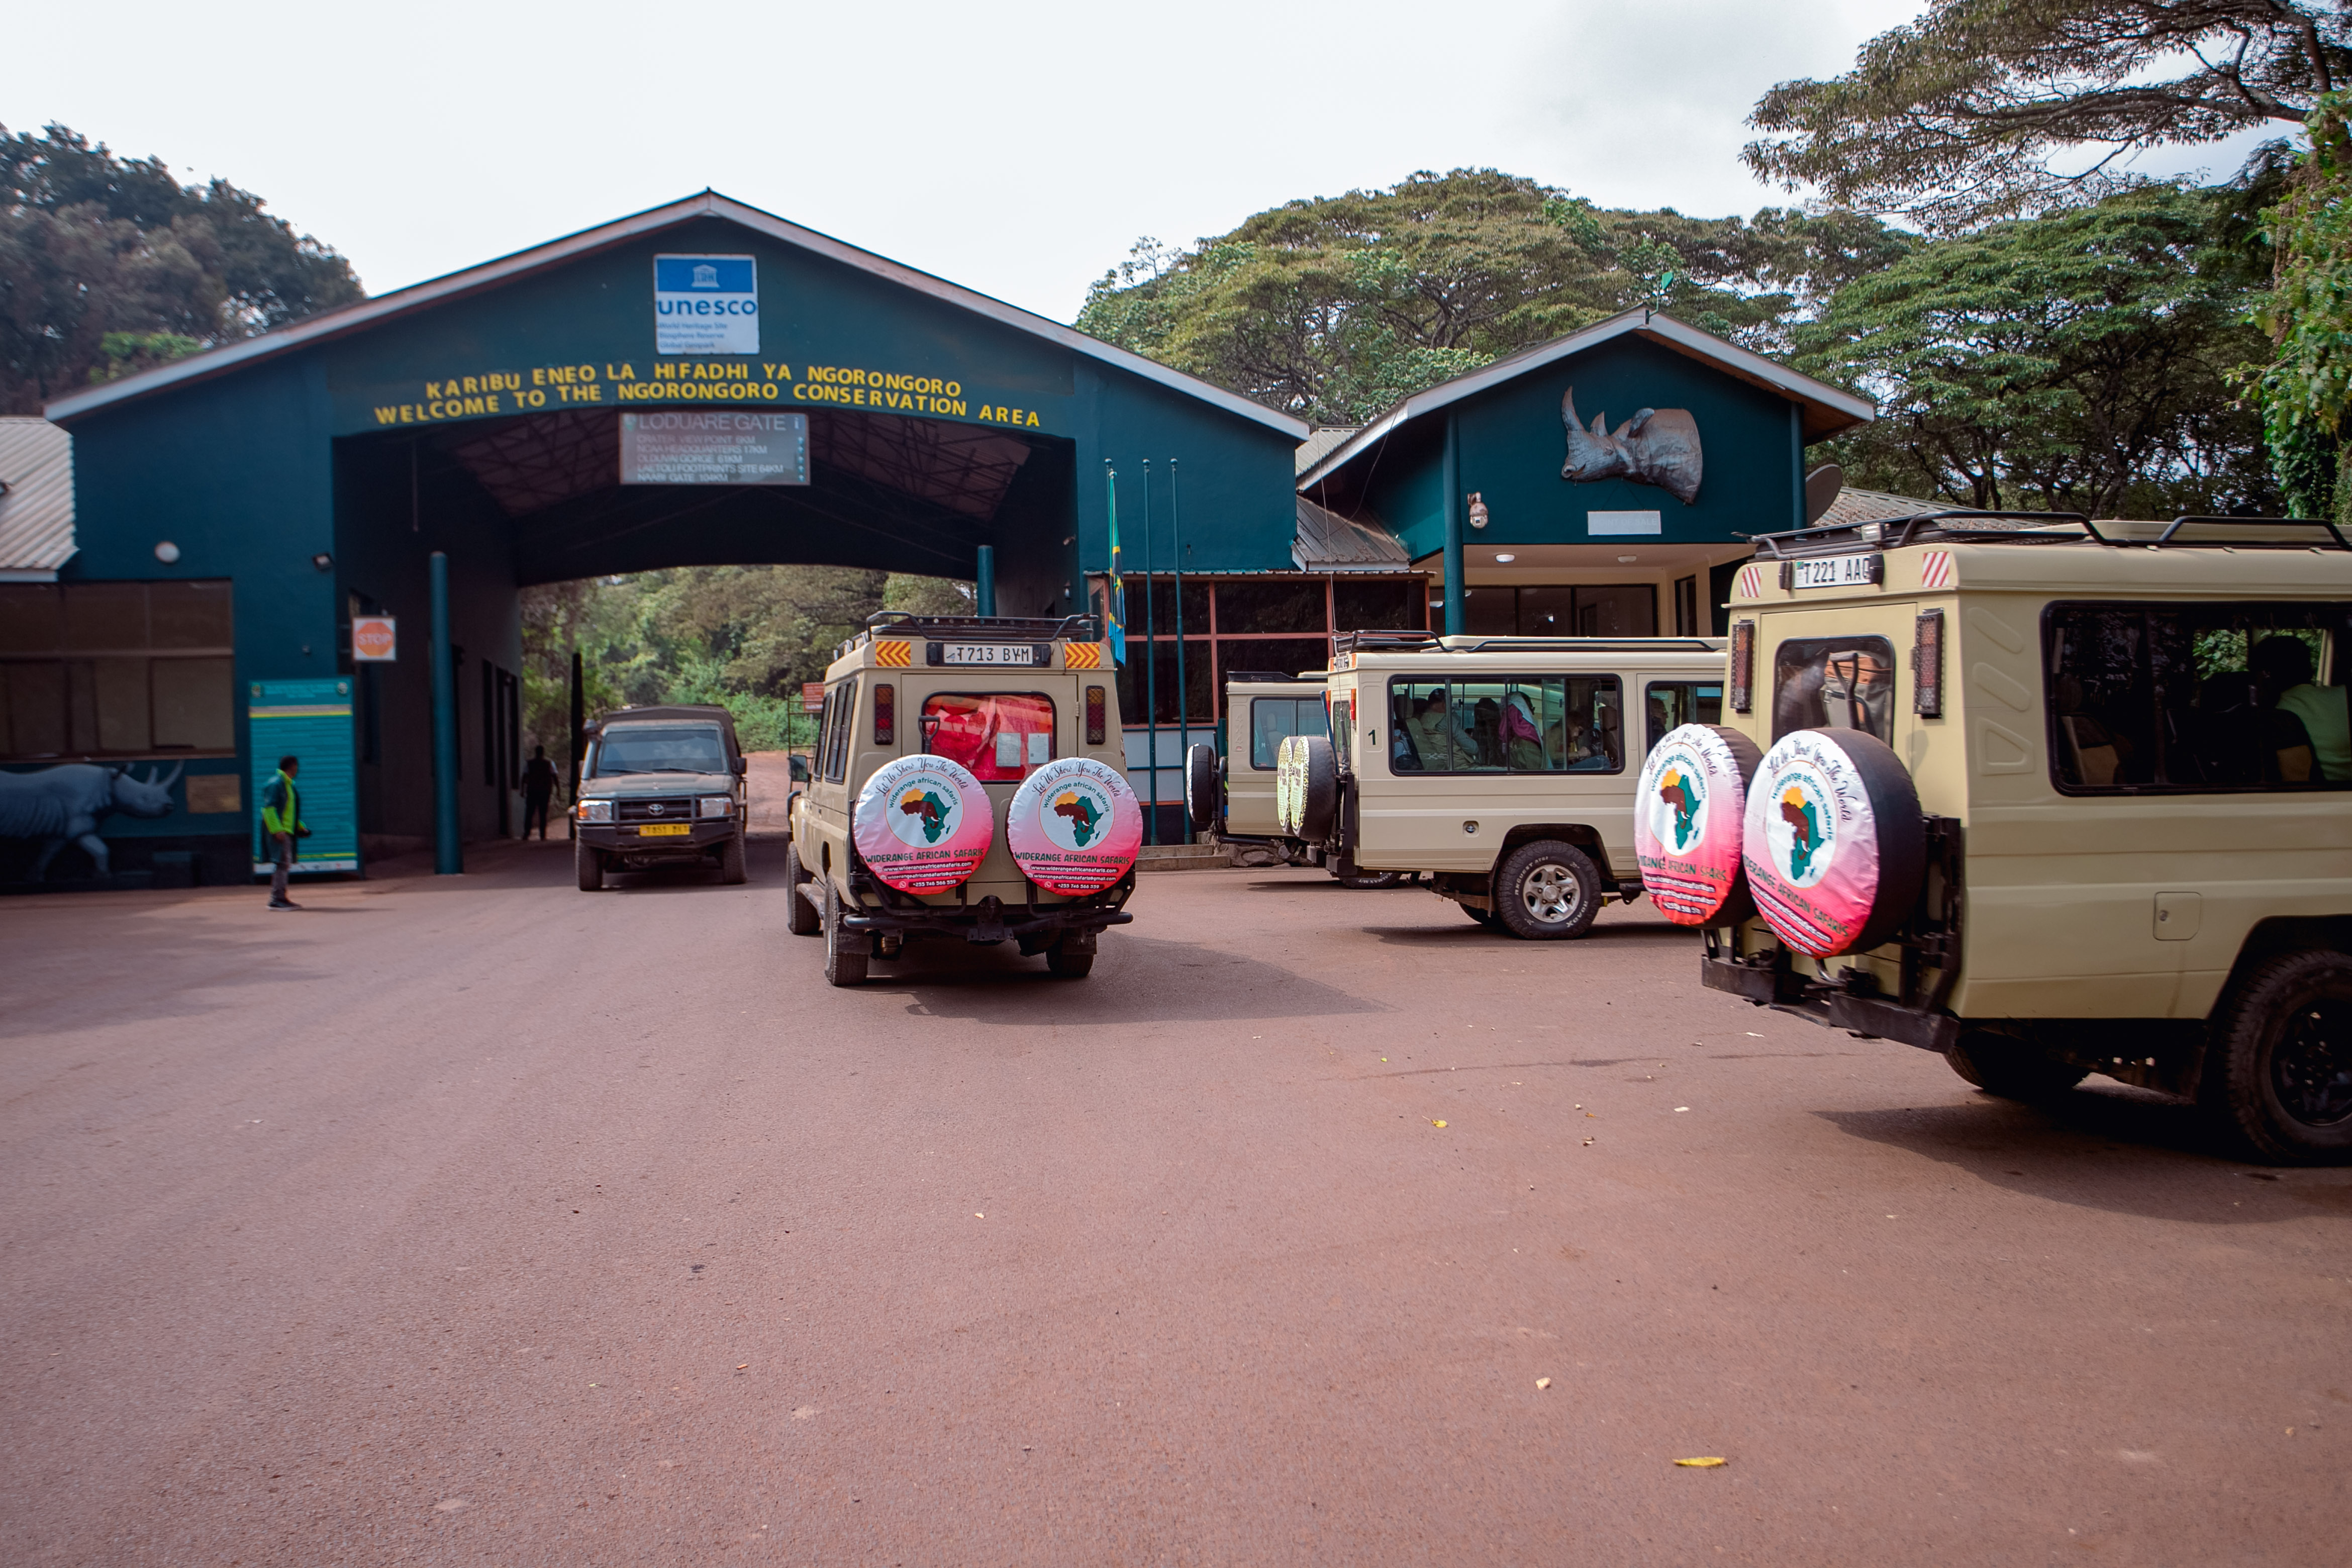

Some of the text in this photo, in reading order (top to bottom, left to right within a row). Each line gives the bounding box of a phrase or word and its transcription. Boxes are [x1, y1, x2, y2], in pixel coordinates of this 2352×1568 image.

[658, 300, 756, 315] unesco
[426, 362, 961, 400] KARIBU ENEO LA HIFADHI YA NGORONGORO
[374, 382, 1040, 427] WELCOME TO THE NGORONGORO CONSERVATION AREA
[639, 413, 787, 431] LODUARE GATE
[669, 473, 695, 482] GATE
[1592, 518, 1657, 526] POINT OF SALE
[358, 633, 392, 645] STOP
[1003, 648, 1029, 661] BYM
[1367, 729, 1377, 746] 1
[893, 762, 914, 776] Show
[918, 757, 933, 773] You
[936, 760, 949, 773] The
[948, 767, 968, 790] World
[1032, 783, 1046, 797] Let
[1051, 765, 1072, 778] Show
[1076, 761, 1092, 777] You
[1092, 766, 1104, 779] The
[1104, 774, 1122, 798] World
[889, 777, 958, 809] widerange african safaris
[1043, 781, 1110, 813] widerange african safaris
[865, 848, 984, 863] WIDERANGE AFRICAN SAFARIS
[1014, 852, 1130, 864] WIDERANGE AFRICAN SAFARIS
[883, 861, 972, 872] www.widerangeafricansafaris.com
[1031, 865, 1117, 873] www.widerangeafricansafaris.com
